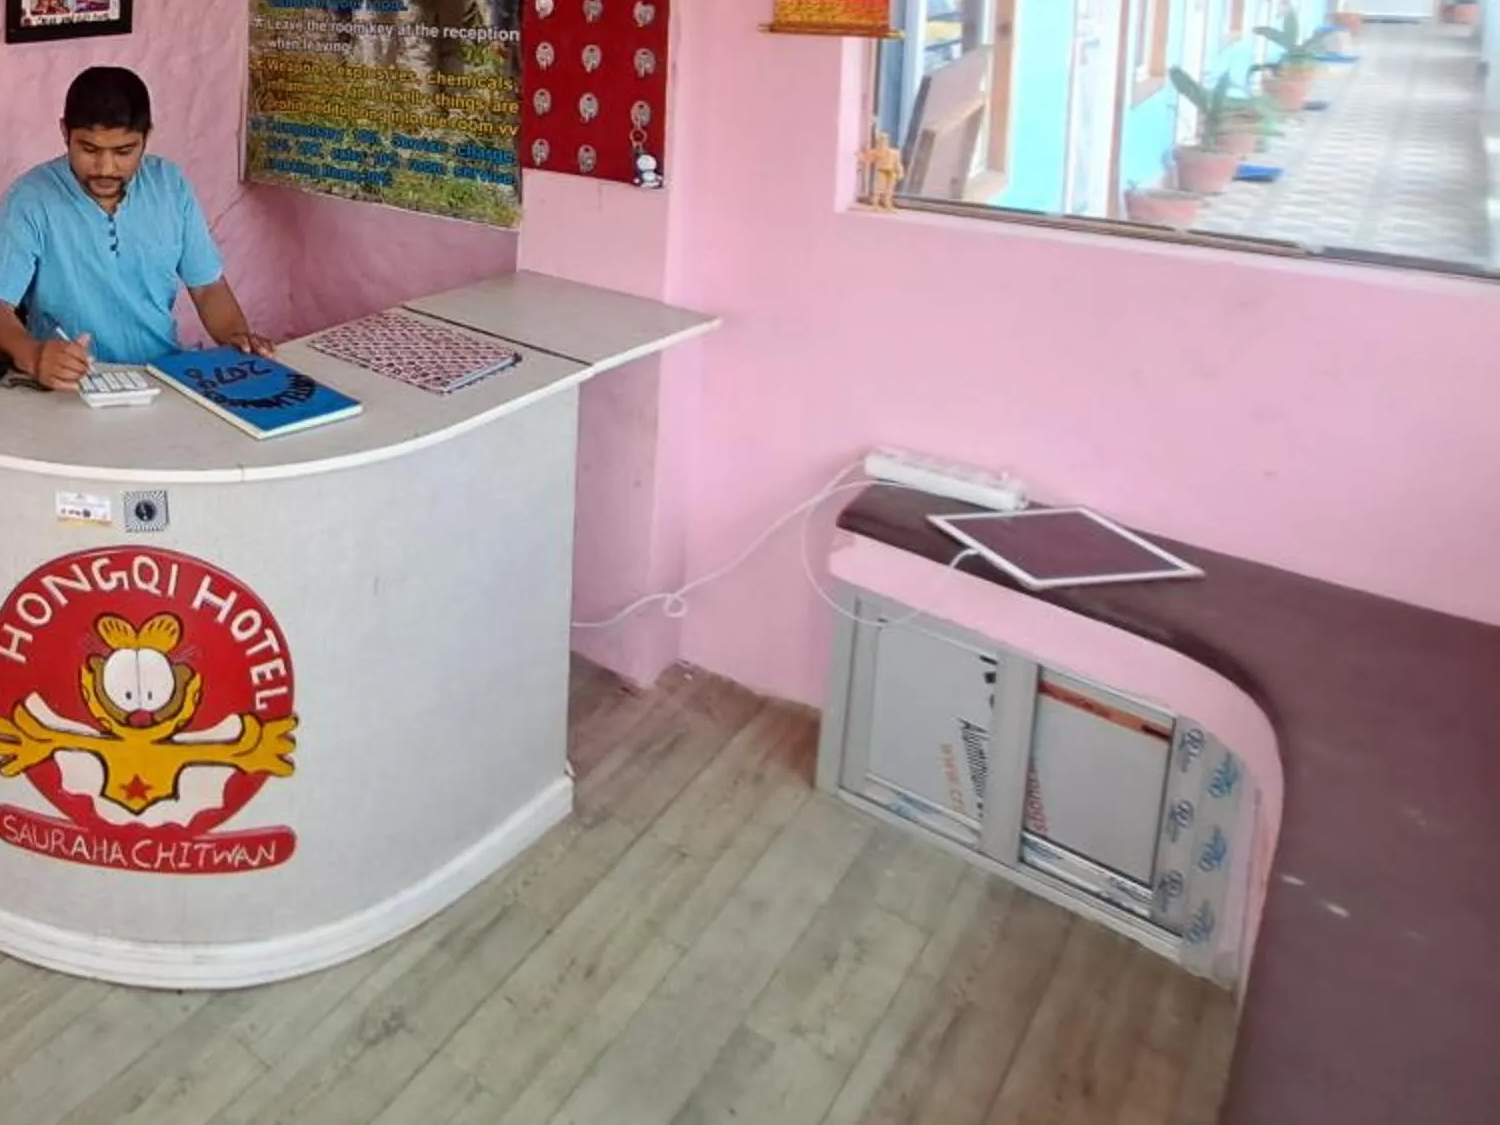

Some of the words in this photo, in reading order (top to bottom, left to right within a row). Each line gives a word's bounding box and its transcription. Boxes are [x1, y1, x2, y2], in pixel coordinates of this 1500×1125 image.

[414, 24, 438, 36] the
[442, 25, 519, 44] reception
[192, 575, 288, 711] HOTEL
[3, 815, 126, 863] SAURAHA
[132, 839, 276, 869] CHITWAN
